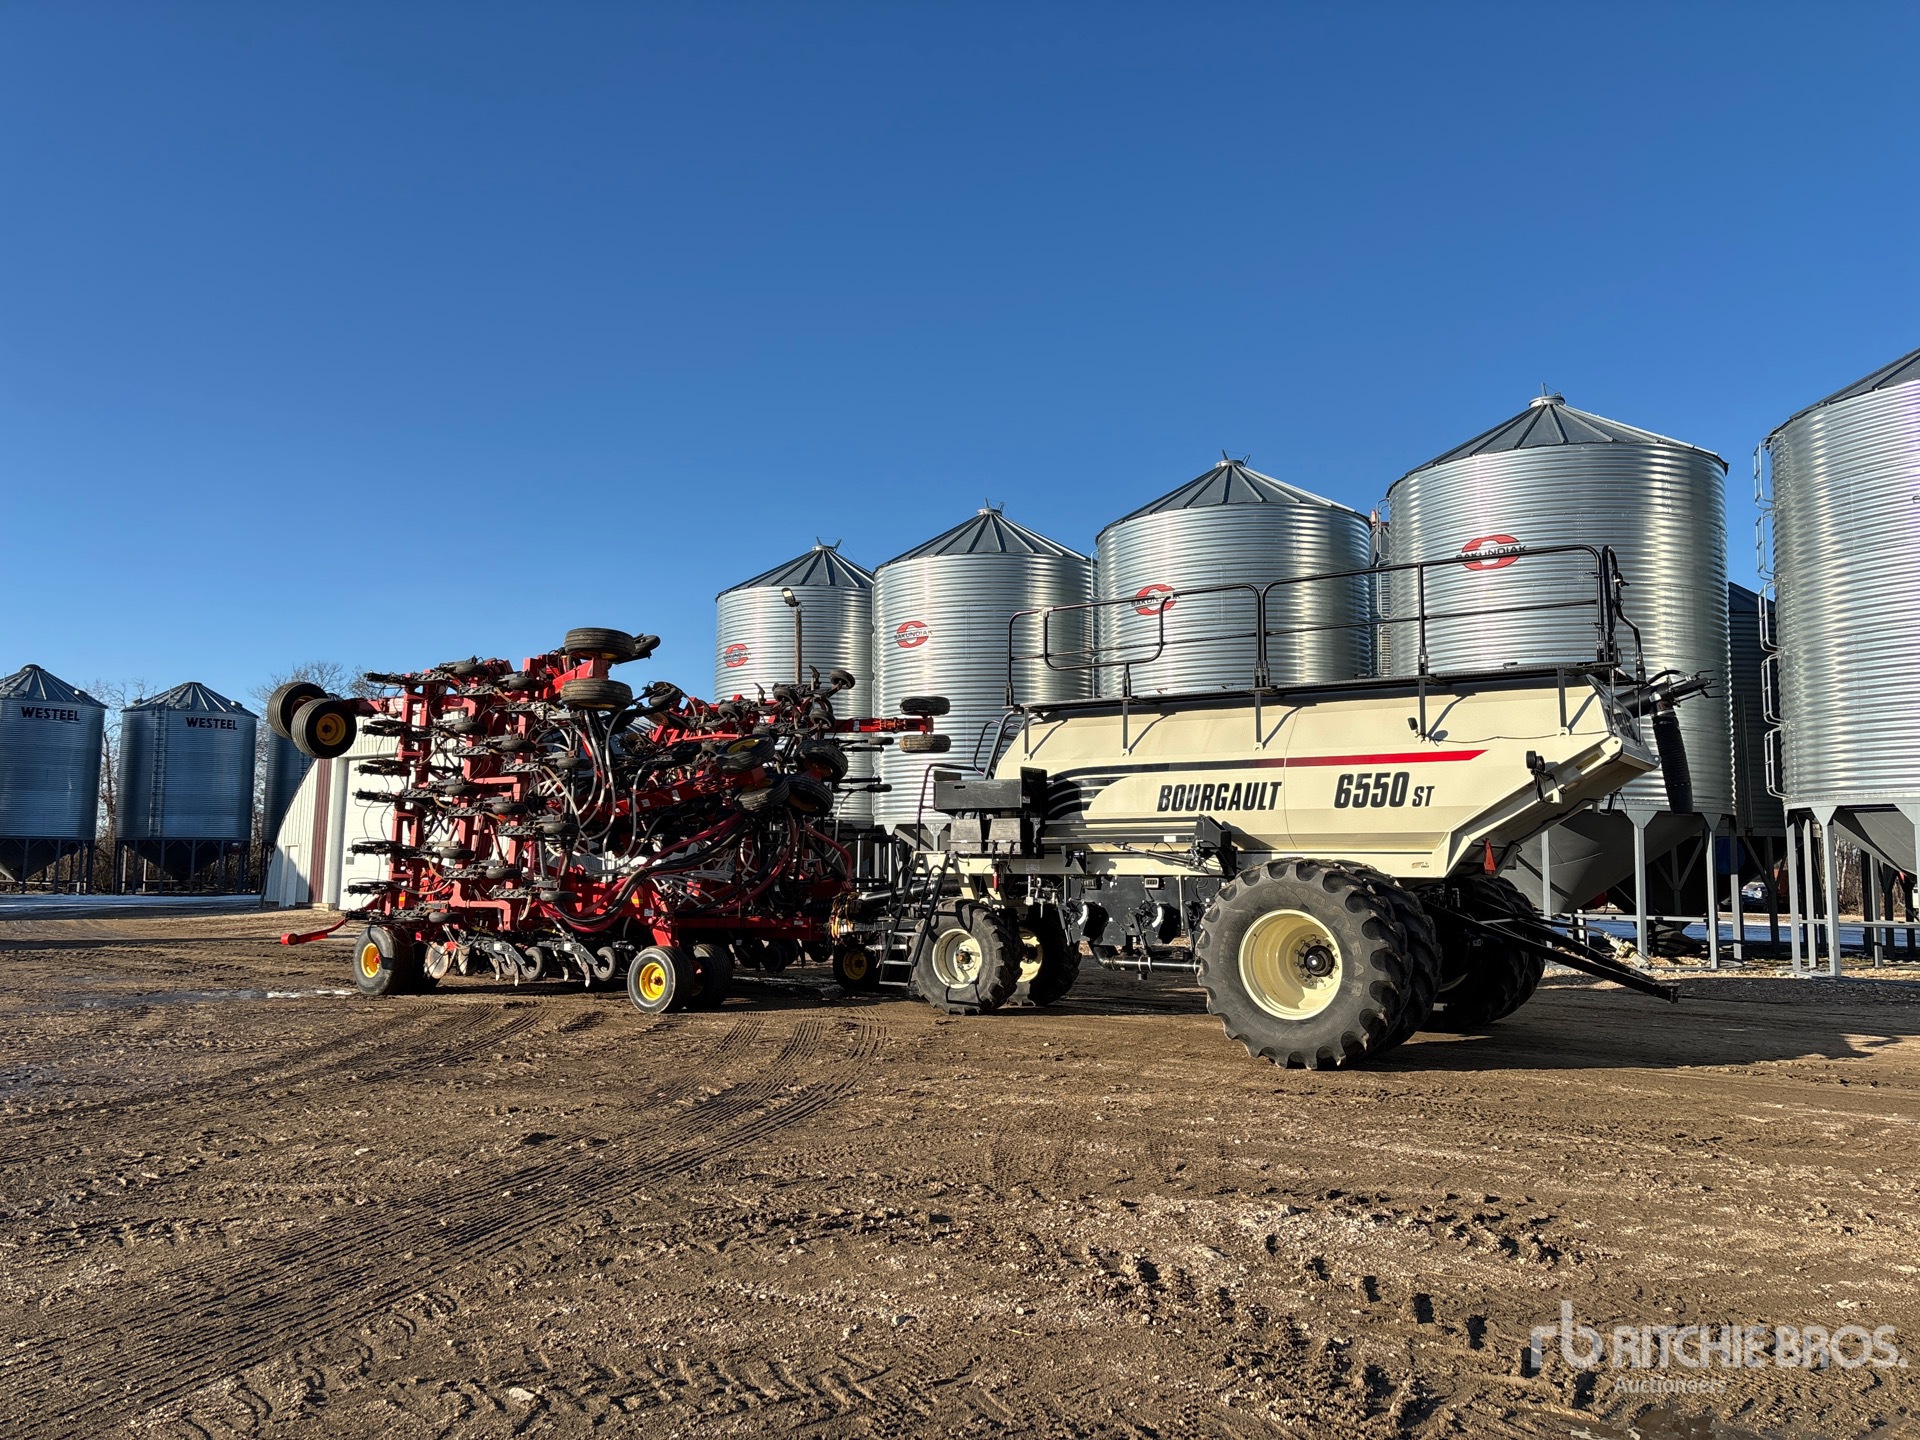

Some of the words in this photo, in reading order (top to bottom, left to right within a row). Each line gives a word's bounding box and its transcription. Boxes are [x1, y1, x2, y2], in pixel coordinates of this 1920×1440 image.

[20, 706, 80, 722] WESTEEL
[185, 716, 238, 731] WESTEEL
[1157, 781, 1283, 812] BOURGAULT
[1334, 771, 1410, 808] 6550
[1412, 785, 1436, 807] ST
